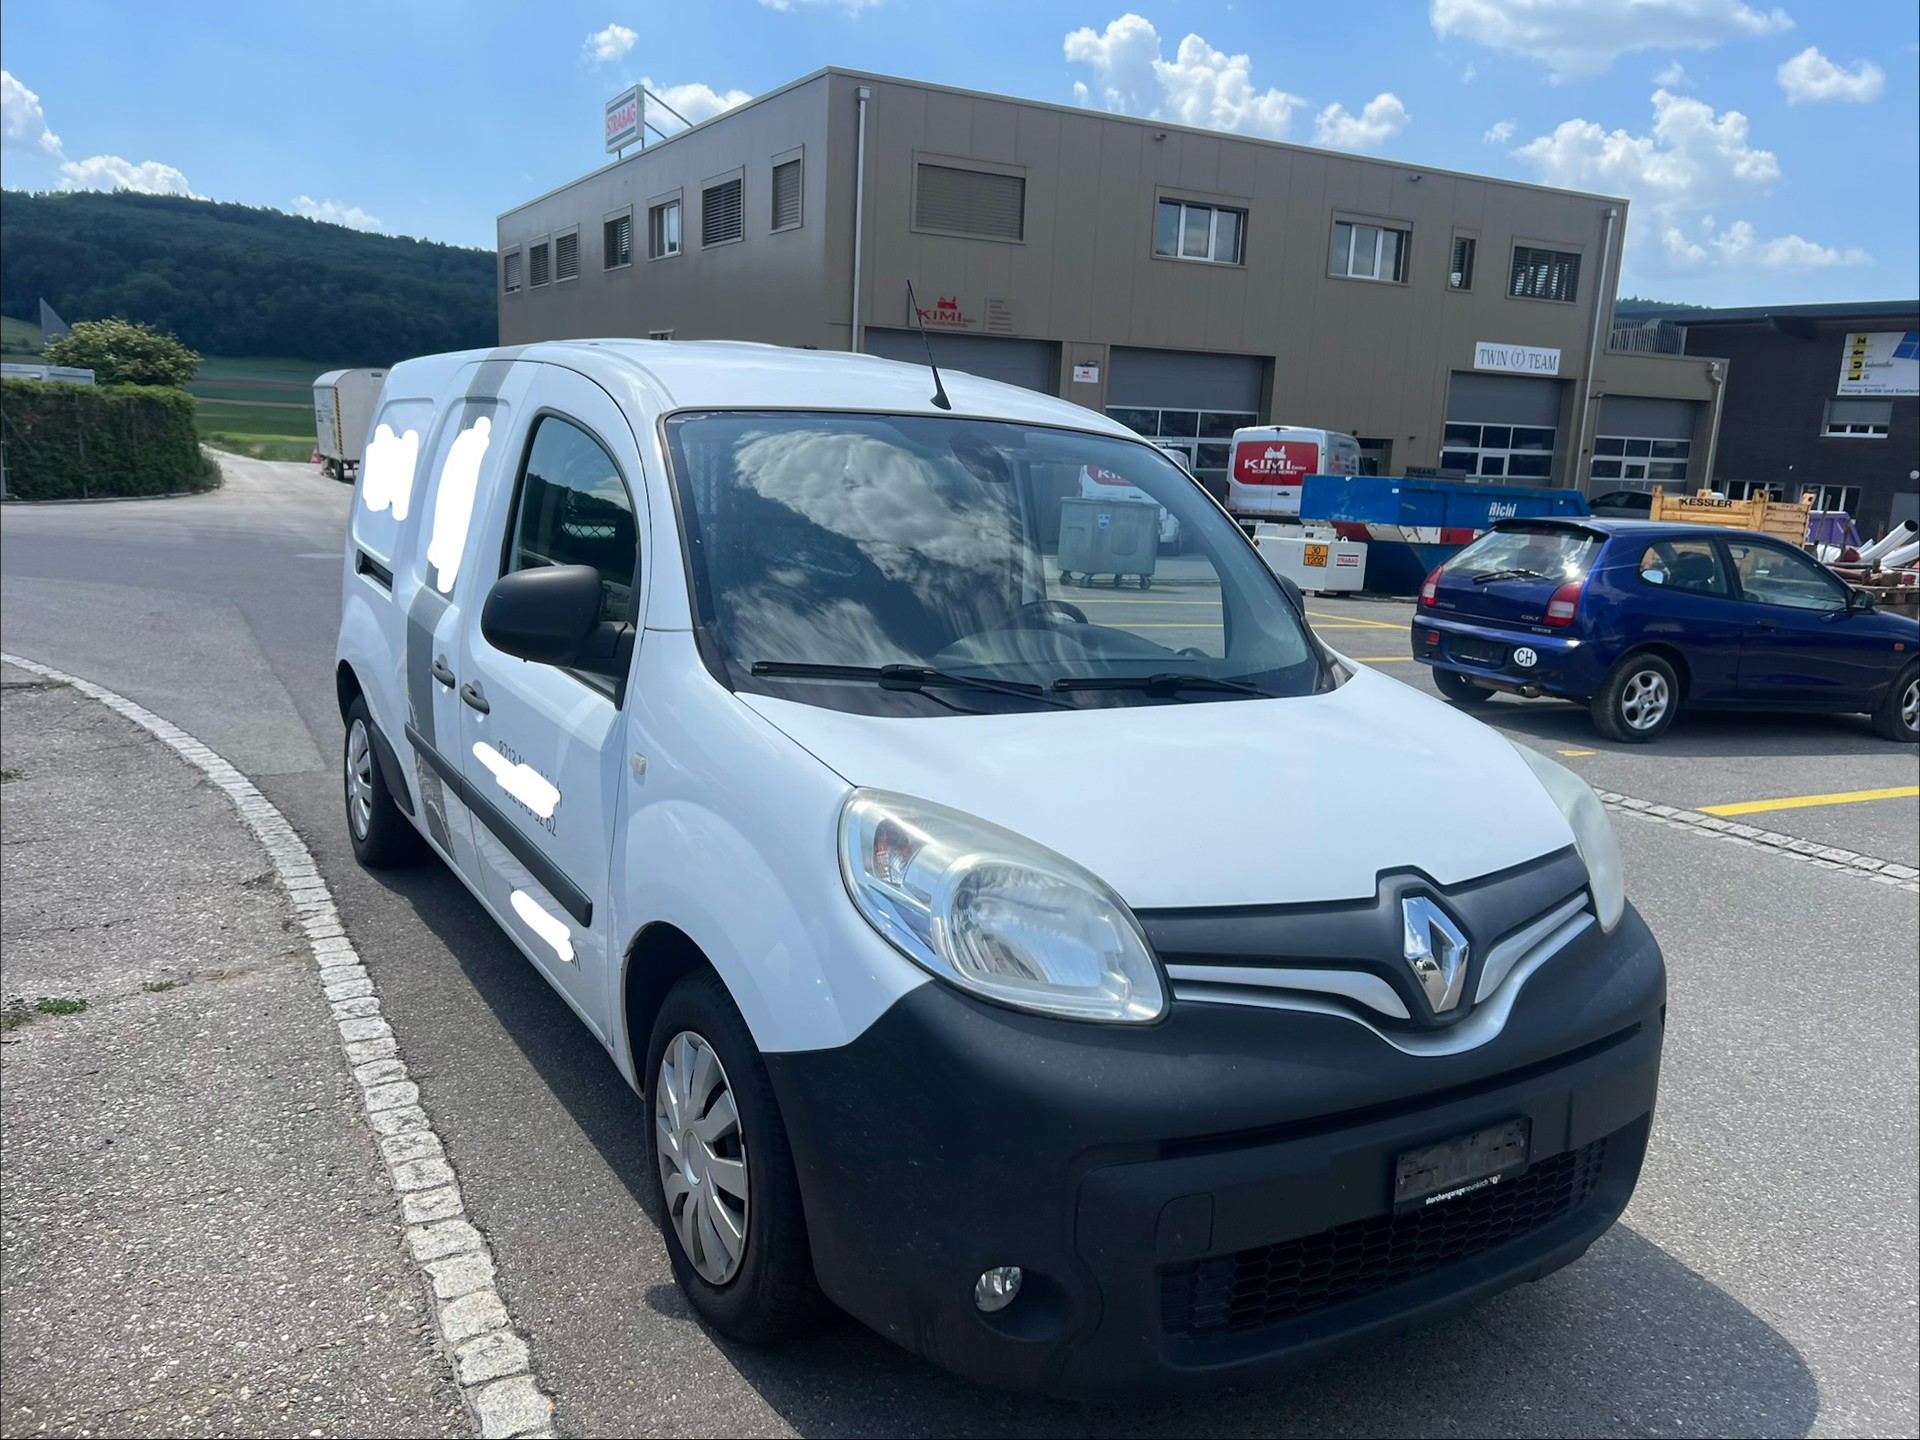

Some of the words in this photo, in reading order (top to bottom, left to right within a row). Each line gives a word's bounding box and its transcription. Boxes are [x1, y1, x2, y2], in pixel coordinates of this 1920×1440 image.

[917, 309, 963, 322] KIMI
[1480, 349, 1508, 366] TWIN
[1528, 353, 1557, 370] TEAM
[1244, 459, 1292, 470] KIMI
[1098, 469, 1121, 479] KI
[1680, 498, 1733, 508] KESSLER
[1488, 502, 1517, 517] Richi
[1311, 546, 1321, 555] 30
[1307, 556, 1324, 565] 1202
[1517, 650, 1533, 664] CH
